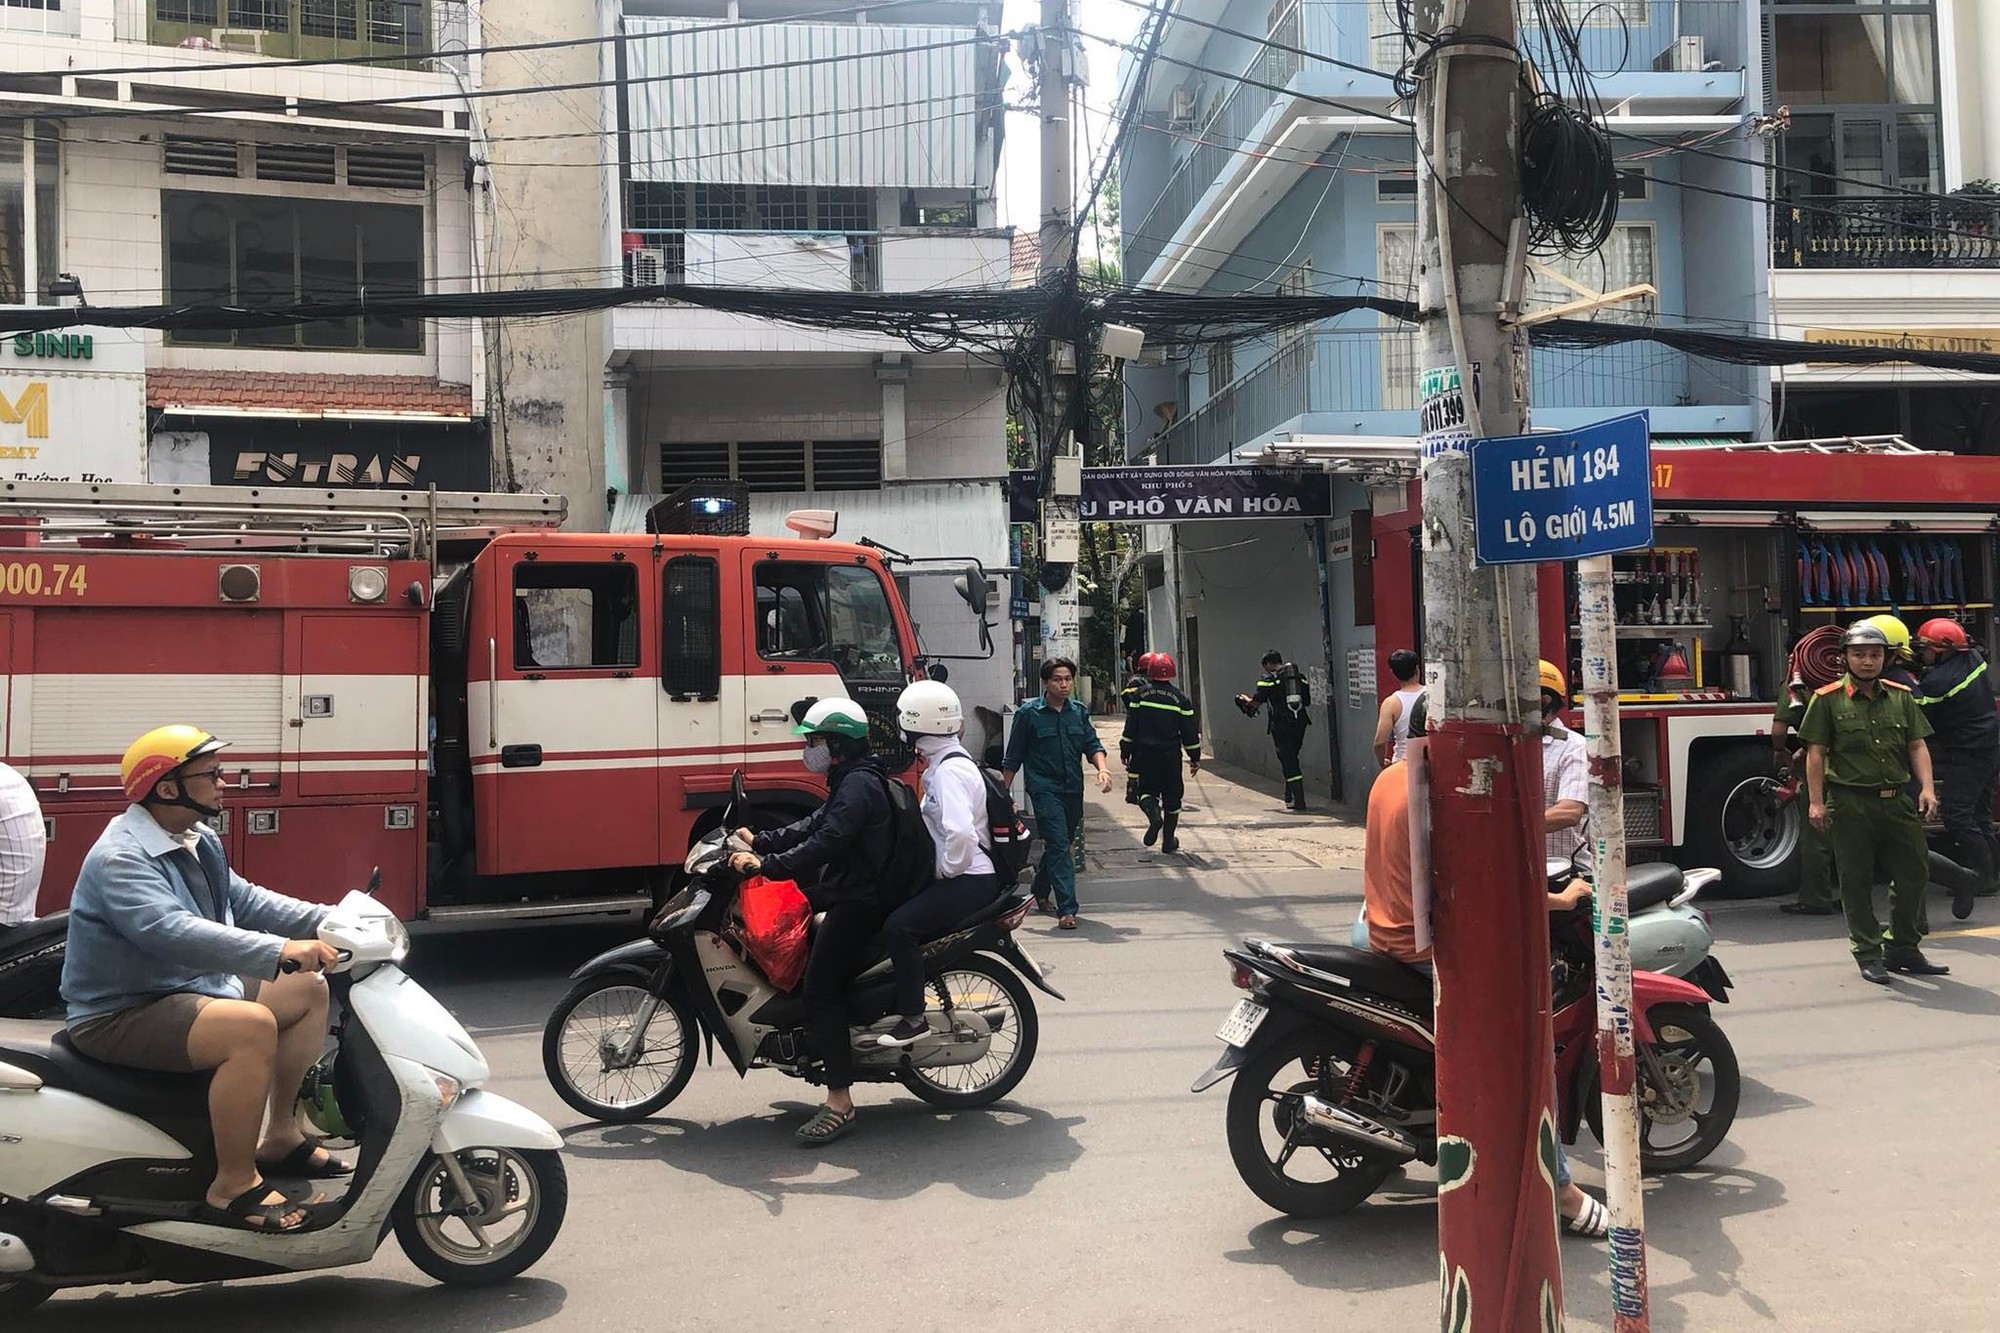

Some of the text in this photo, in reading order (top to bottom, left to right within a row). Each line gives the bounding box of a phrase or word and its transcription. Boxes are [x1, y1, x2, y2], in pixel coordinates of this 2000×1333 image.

[14, 332, 93, 359] SINH
[1130, 471, 1143, 479] XÂY
[1511, 445, 1576, 491] HẺM
[1582, 444, 1620, 484] 184
[1165, 480, 1186, 489] PHỐ
[1109, 494, 1168, 516] PHỐ
[1175, 495, 1233, 514] VĂN
[1243, 492, 1302, 513] HÓA
[1504, 500, 1635, 547] LỘ GIỚI 4.5M
[706, 964, 737, 972] HONDA
